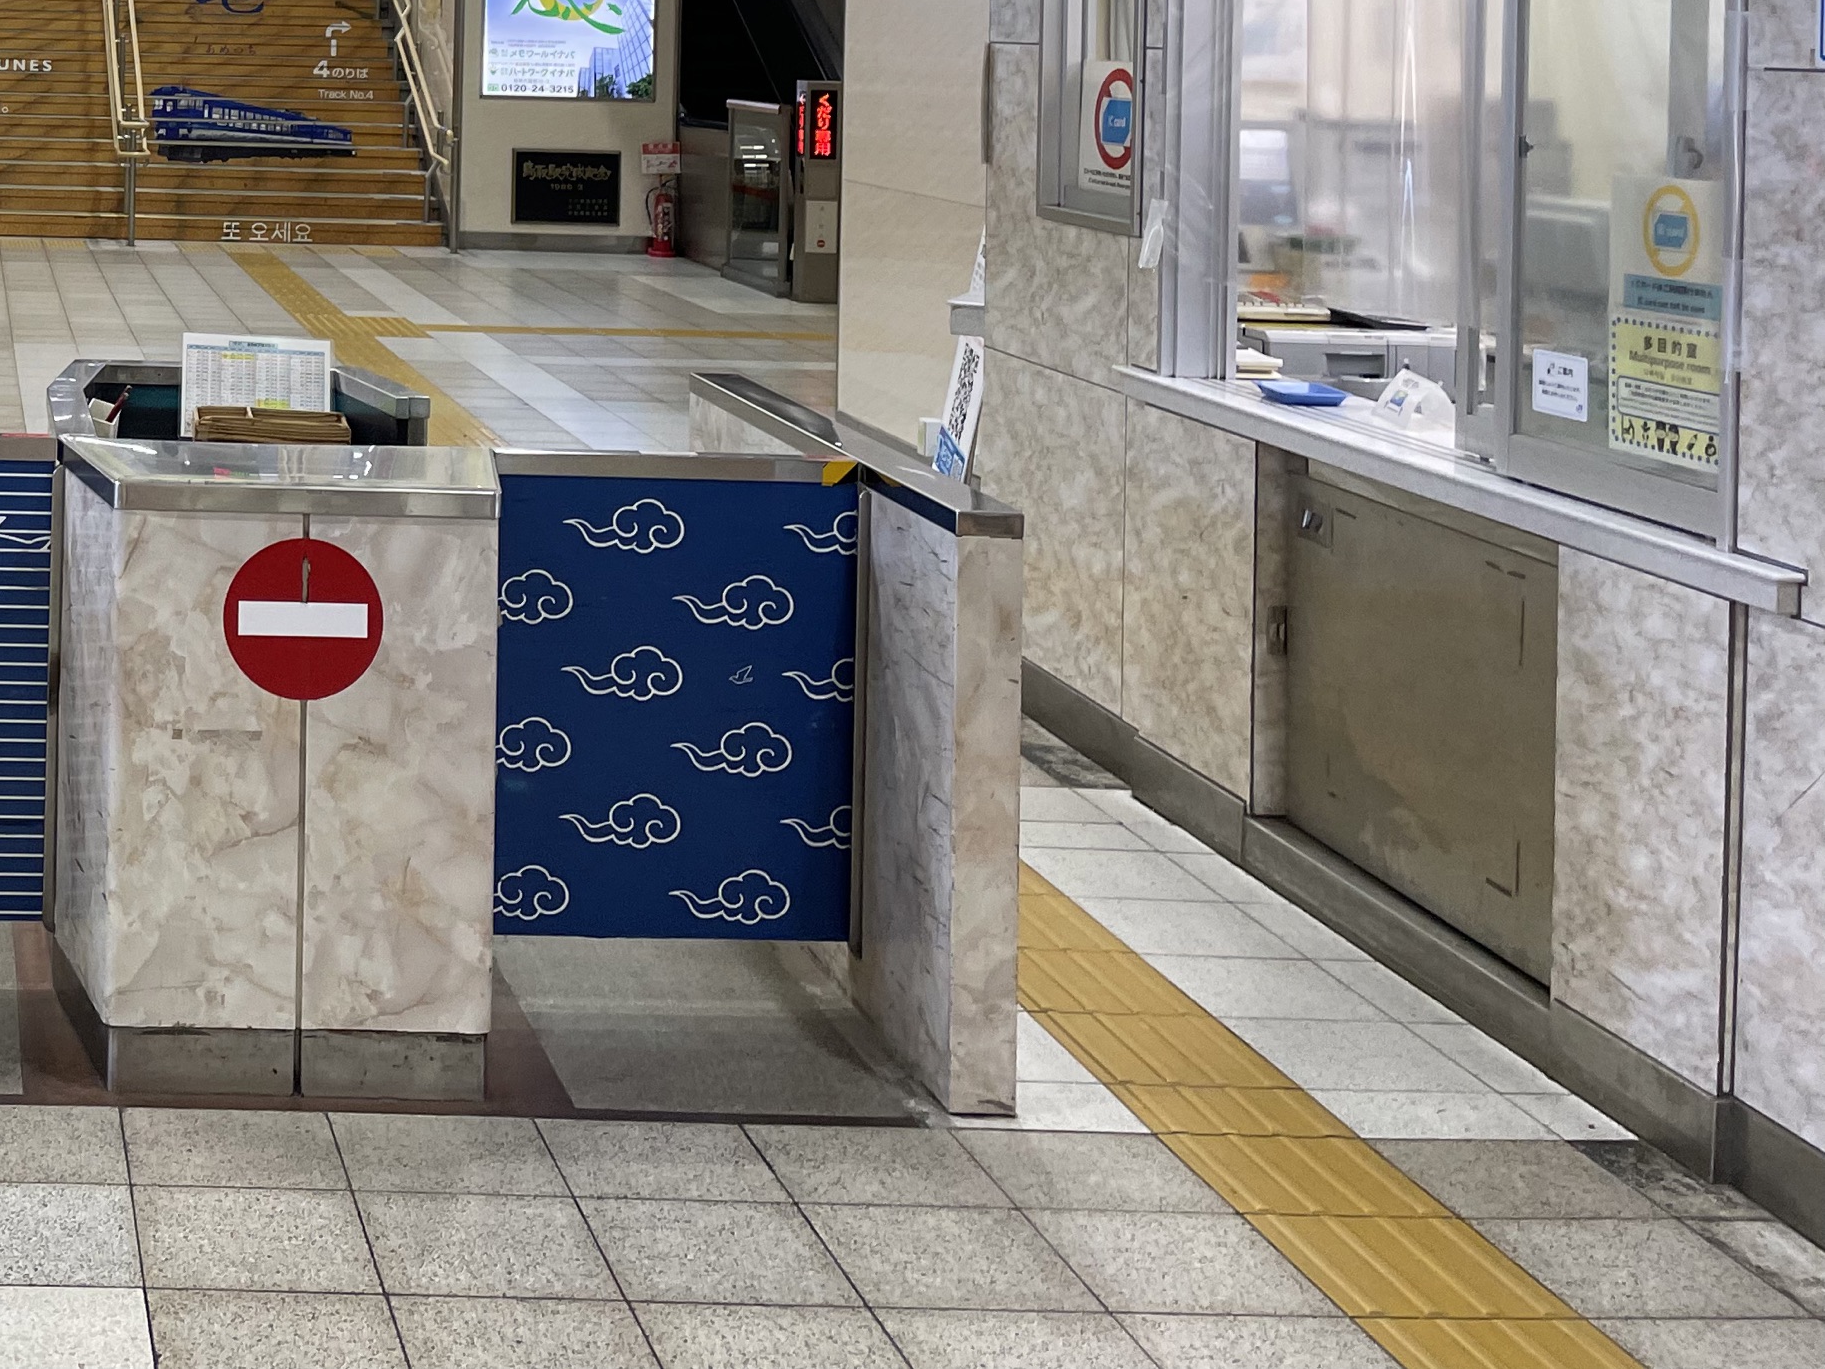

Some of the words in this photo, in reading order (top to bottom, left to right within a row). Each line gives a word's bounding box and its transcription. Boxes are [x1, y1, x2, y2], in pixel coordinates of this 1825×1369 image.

[312, 59, 369, 79] 4のりば
[317, 89, 348, 100] Track
[348, 89, 374, 101] No.4
[220, 221, 242, 242] 또
[248, 220, 313, 243] 오세요
